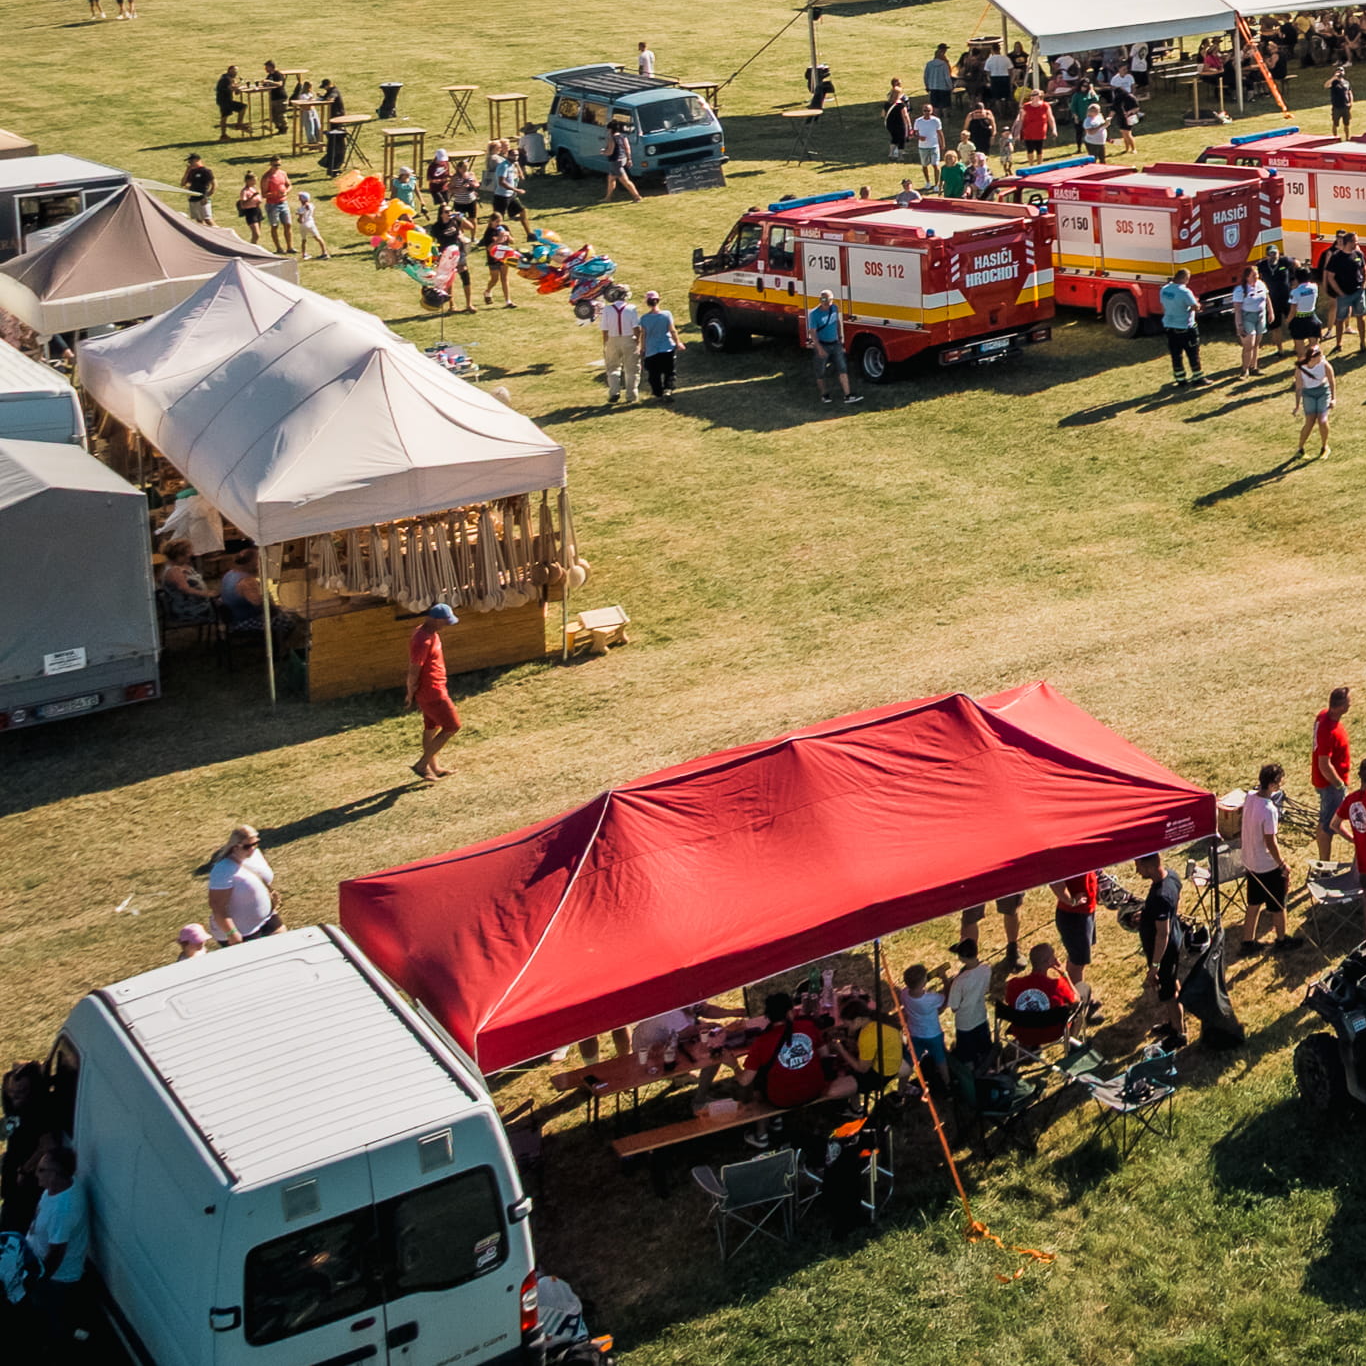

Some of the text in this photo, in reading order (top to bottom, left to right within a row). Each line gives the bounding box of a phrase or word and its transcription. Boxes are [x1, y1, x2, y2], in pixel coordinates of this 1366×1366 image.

[1053, 187, 1080, 202] HASIČI
[1286, 182, 1304, 195] 150
[1333, 185, 1351, 199] SOS
[1212, 203, 1248, 225] HASIČI
[1071, 216, 1089, 231] 150
[1116, 219, 1155, 235] SOS 112
[818, 256, 836, 271] 150
[974, 247, 1012, 270] HASIČI
[864, 261, 904, 279] SOS 112
[965, 259, 1020, 288] HROCHOŤ
